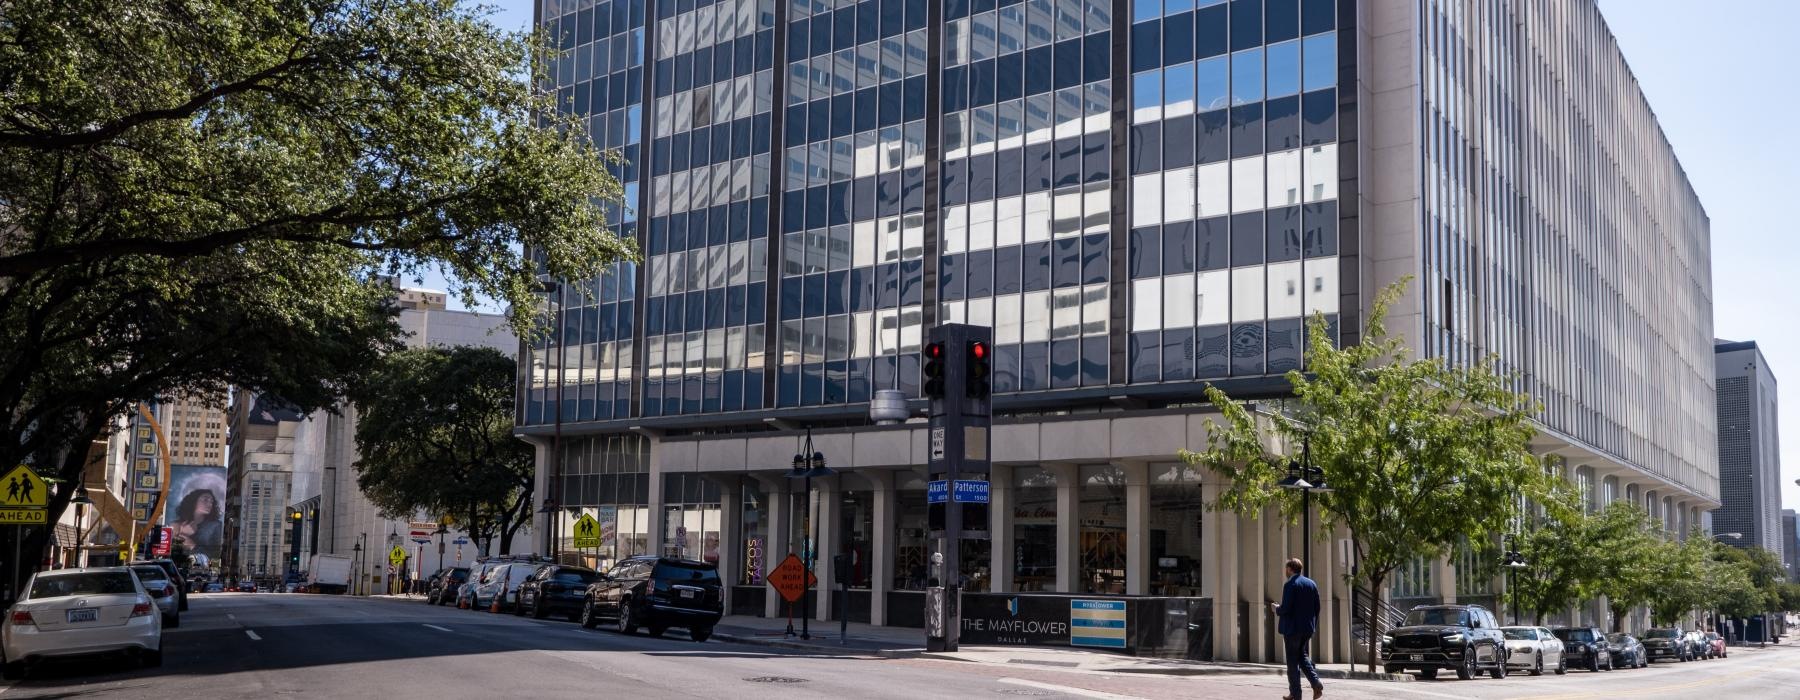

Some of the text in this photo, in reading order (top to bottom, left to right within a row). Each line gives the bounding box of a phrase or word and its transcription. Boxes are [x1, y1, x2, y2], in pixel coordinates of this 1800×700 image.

[934, 430, 943, 438] ONE
[929, 482, 948, 493] Akard
[954, 482, 988, 493] Patterson
[0, 511, 42, 521] AHEAD
[780, 583, 804, 591] AHEAD
[962, 618, 985, 631] THE
[988, 619, 1067, 634] MAYFLOWER
[997, 636, 1028, 644] DALLAS
